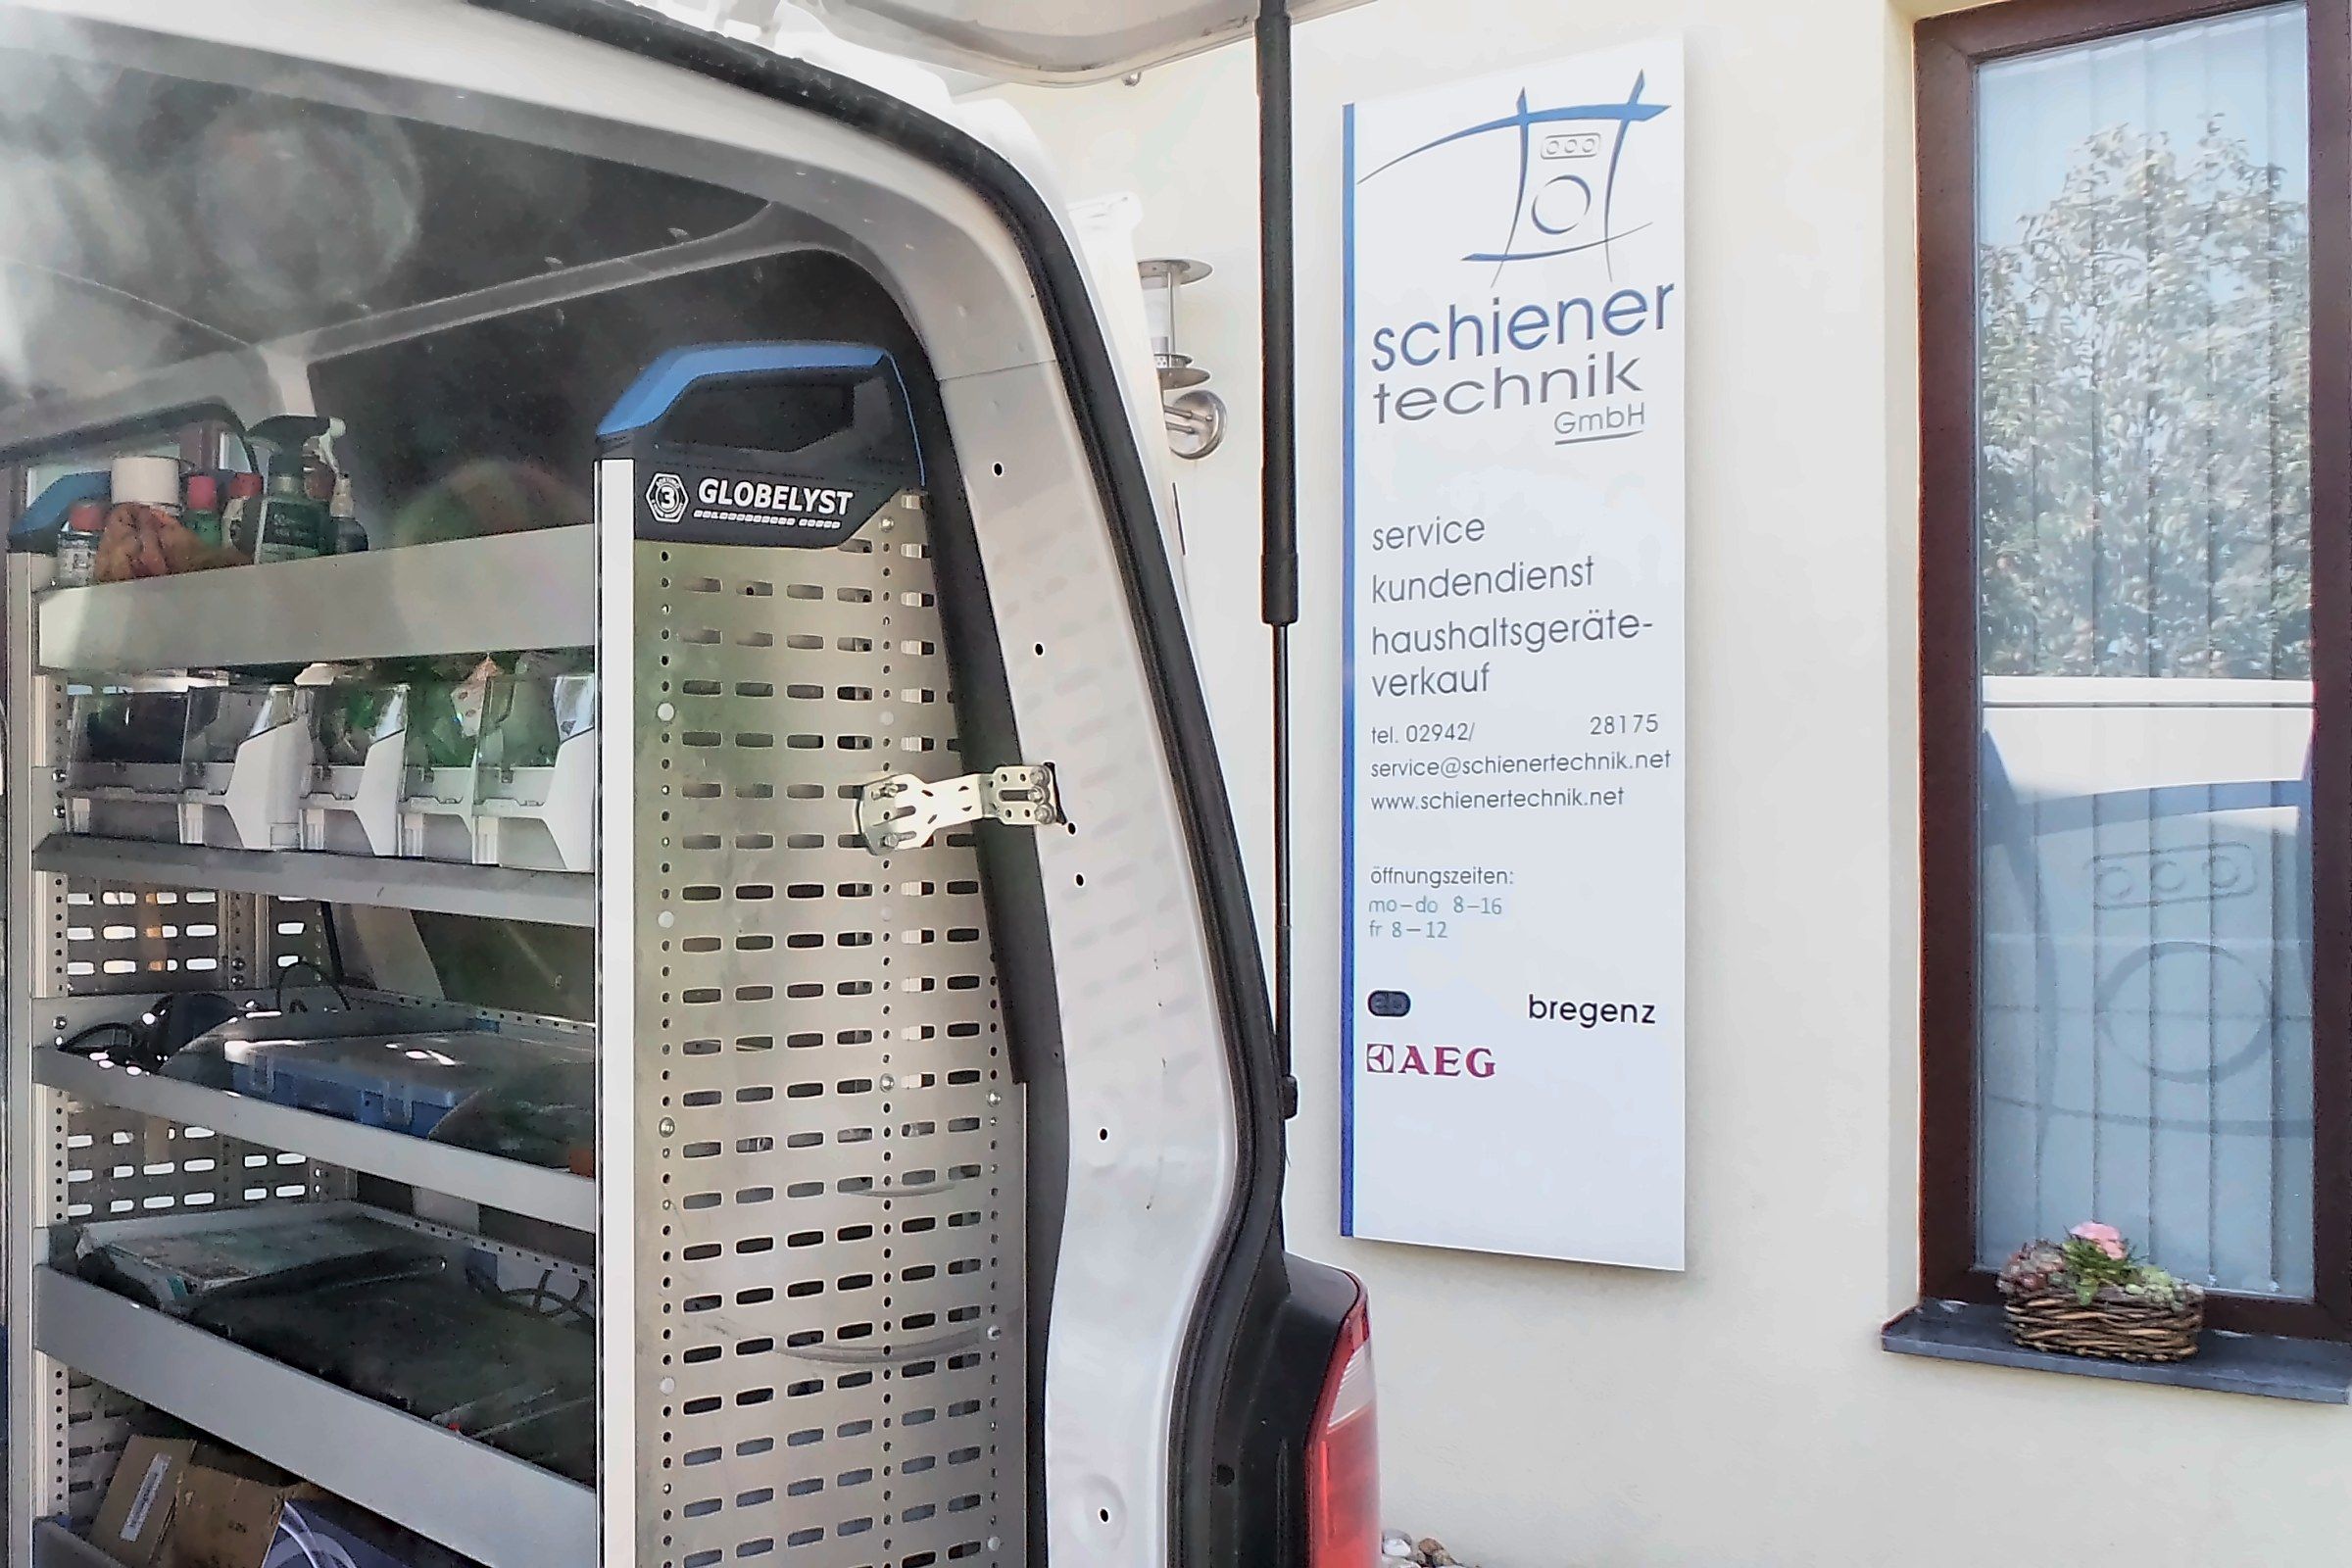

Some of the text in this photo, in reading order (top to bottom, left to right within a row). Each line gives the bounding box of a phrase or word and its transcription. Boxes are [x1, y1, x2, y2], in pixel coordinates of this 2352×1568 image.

[1371, 282, 1675, 371] schiener
[1372, 350, 1644, 424] technik
[1553, 402, 1645, 434] GmbH
[698, 477, 854, 515] GLOBELYST
[1372, 515, 1486, 551] service
[1372, 555, 1594, 604] kundendienst
[1372, 609, 1653, 655] haushaltsgeräte-
[1371, 662, 1491, 697] verkauf
[1371, 713, 1659, 744] tel. 02942/ 28175
[1371, 749, 1672, 778] service@schienertechnik.net
[1371, 787, 1625, 810] www.schienertechnik.net
[1370, 866, 1514, 889] öffnungszeiten:
[1528, 994, 1656, 1028] bregenz
[1397, 1045, 1496, 1078] AEG
